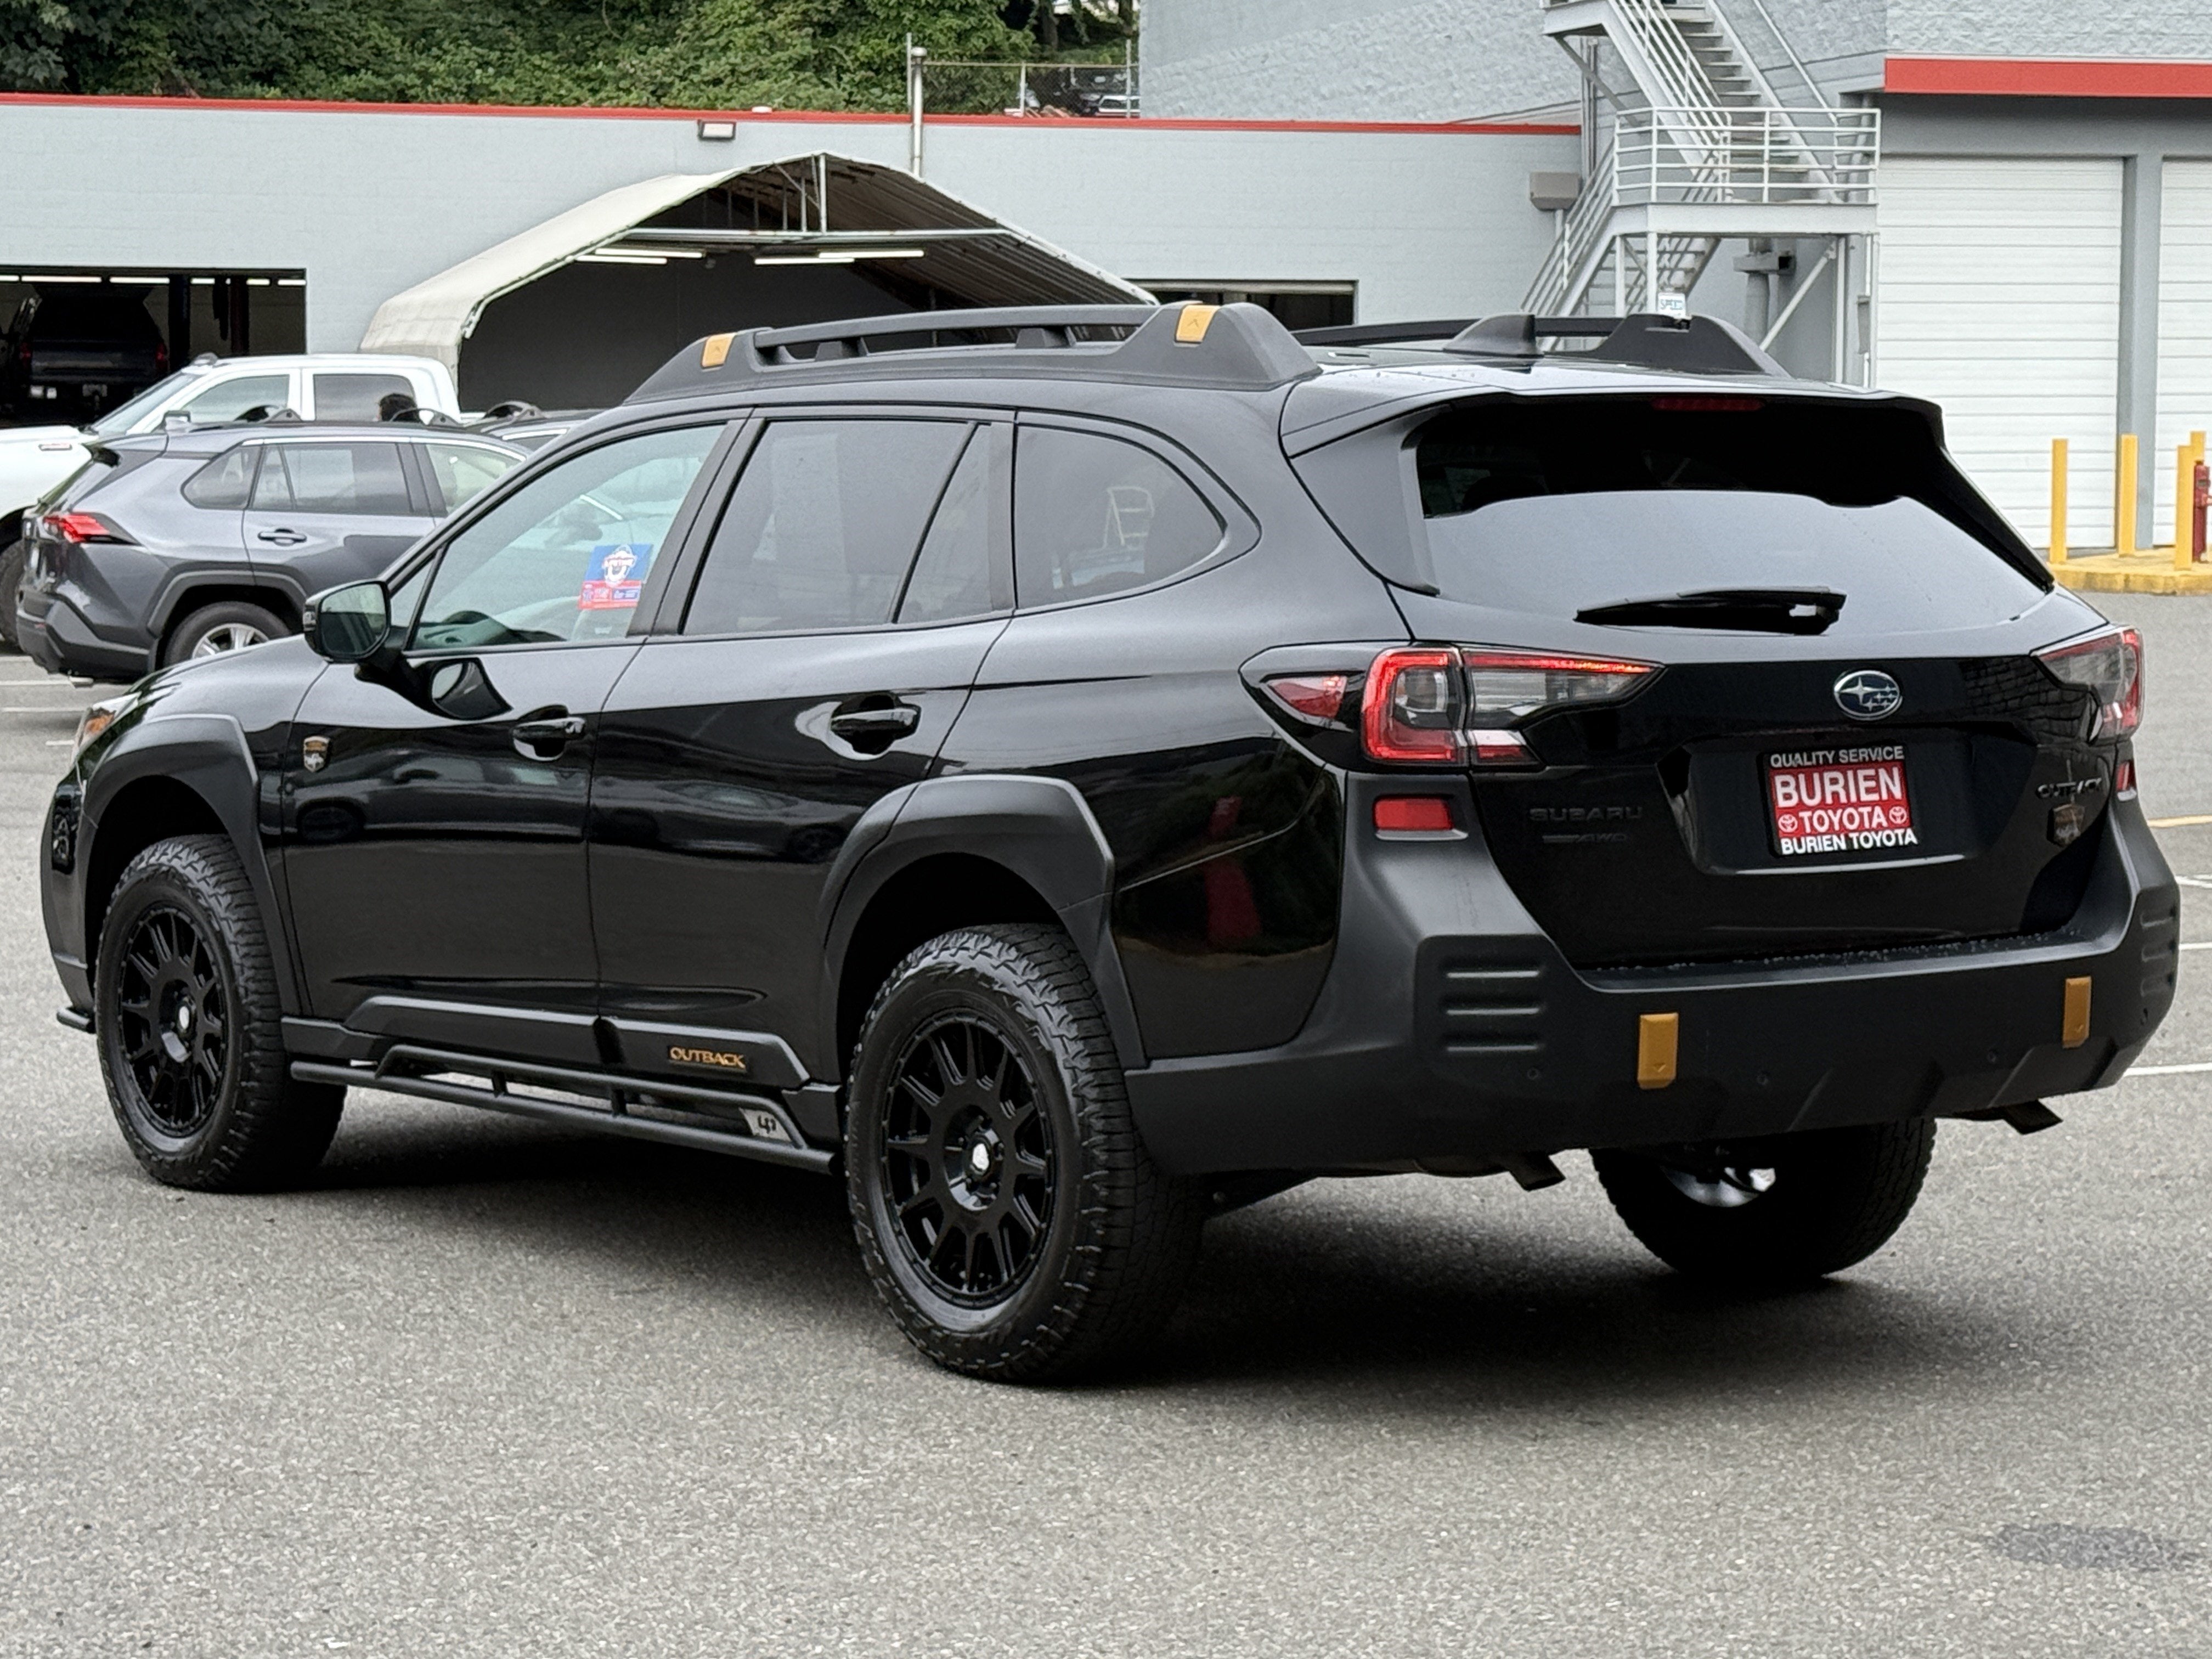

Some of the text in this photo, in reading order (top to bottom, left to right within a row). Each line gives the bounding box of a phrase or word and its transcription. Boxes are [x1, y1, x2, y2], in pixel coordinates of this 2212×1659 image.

[1770, 746, 1905, 768] QUALITY SERVICE
[1774, 766, 1903, 808] BURIEN
[1530, 806, 1643, 821] SUBARU
[1798, 805, 1888, 833] TOYOTA
[1780, 828, 1918, 855] BURIEN TOYOTA
[670, 1046, 747, 1069] OUTBACK
